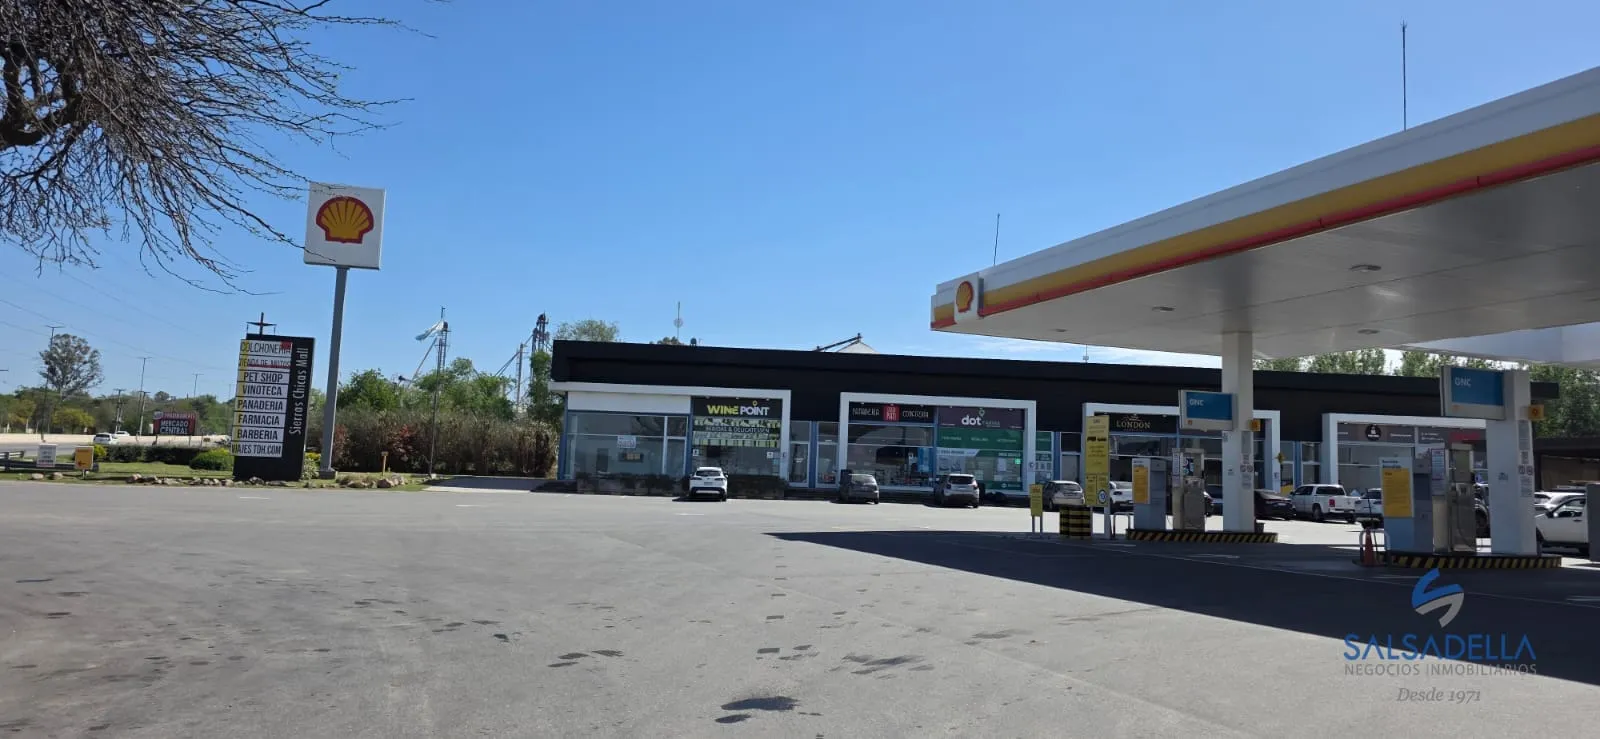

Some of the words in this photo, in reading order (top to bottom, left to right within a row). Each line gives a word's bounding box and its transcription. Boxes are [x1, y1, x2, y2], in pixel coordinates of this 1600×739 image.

[296, 348, 309, 369] Mall
[244, 371, 259, 381] PET
[260, 373, 283, 382] SHOP
[1454, 376, 1471, 387] GNC
[293, 369, 307, 399] Chicas
[242, 385, 282, 396] VINOTECA
[238, 400, 283, 411] PANADERIA
[1189, 398, 1204, 406] GNC
[706, 404, 739, 415] WINE
[740, 406, 770, 416] POINT
[238, 414, 279, 425] FARMACIA
[289, 398, 304, 435] Sierras
[961, 414, 982, 426] dot
[1116, 420, 1151, 429] LONDON
[237, 429, 278, 440] BARBERIA
[231, 444, 252, 455] VIAJES
